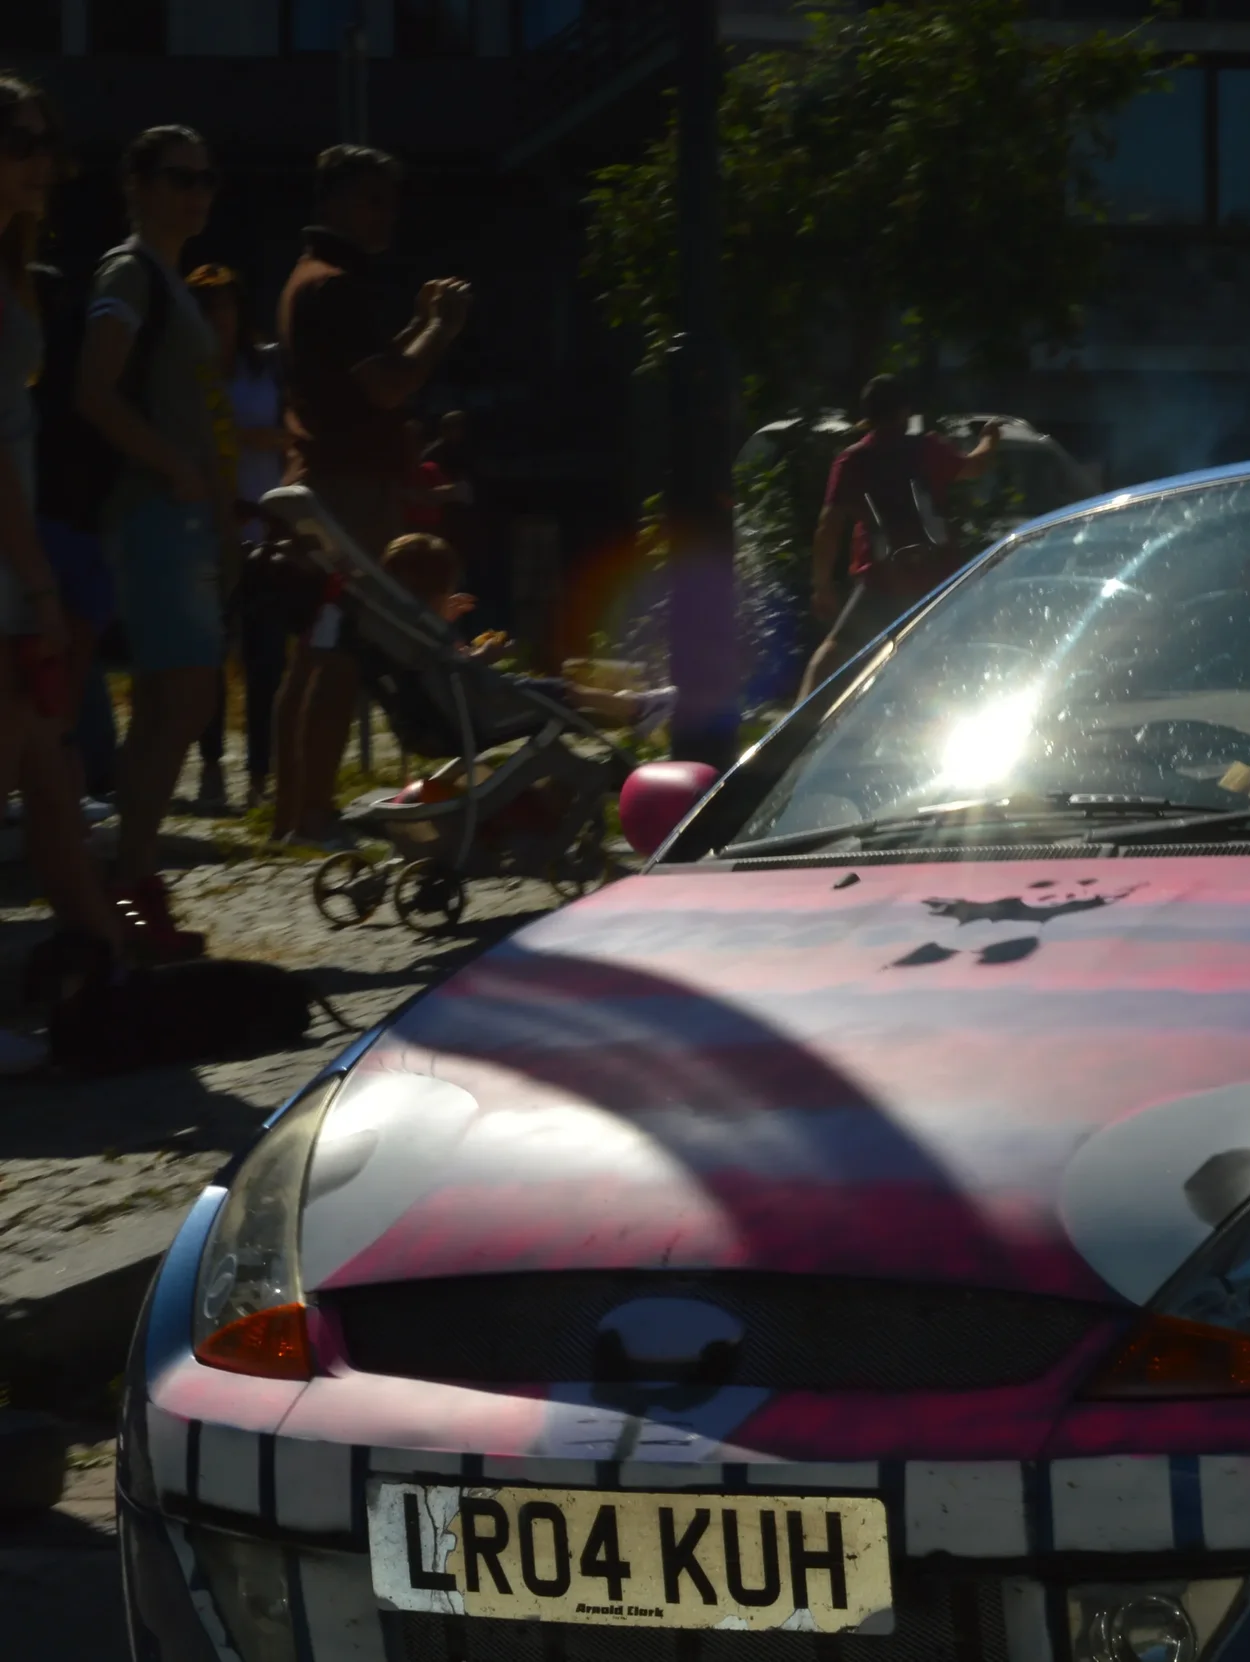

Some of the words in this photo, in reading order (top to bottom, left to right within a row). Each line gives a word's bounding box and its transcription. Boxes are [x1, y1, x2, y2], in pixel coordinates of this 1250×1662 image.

[403, 1492, 631, 1602] LR04
[658, 1506, 848, 1610] KUH
[575, 1603, 624, 1616] Arnold
[626, 1605, 665, 1618] Clark
